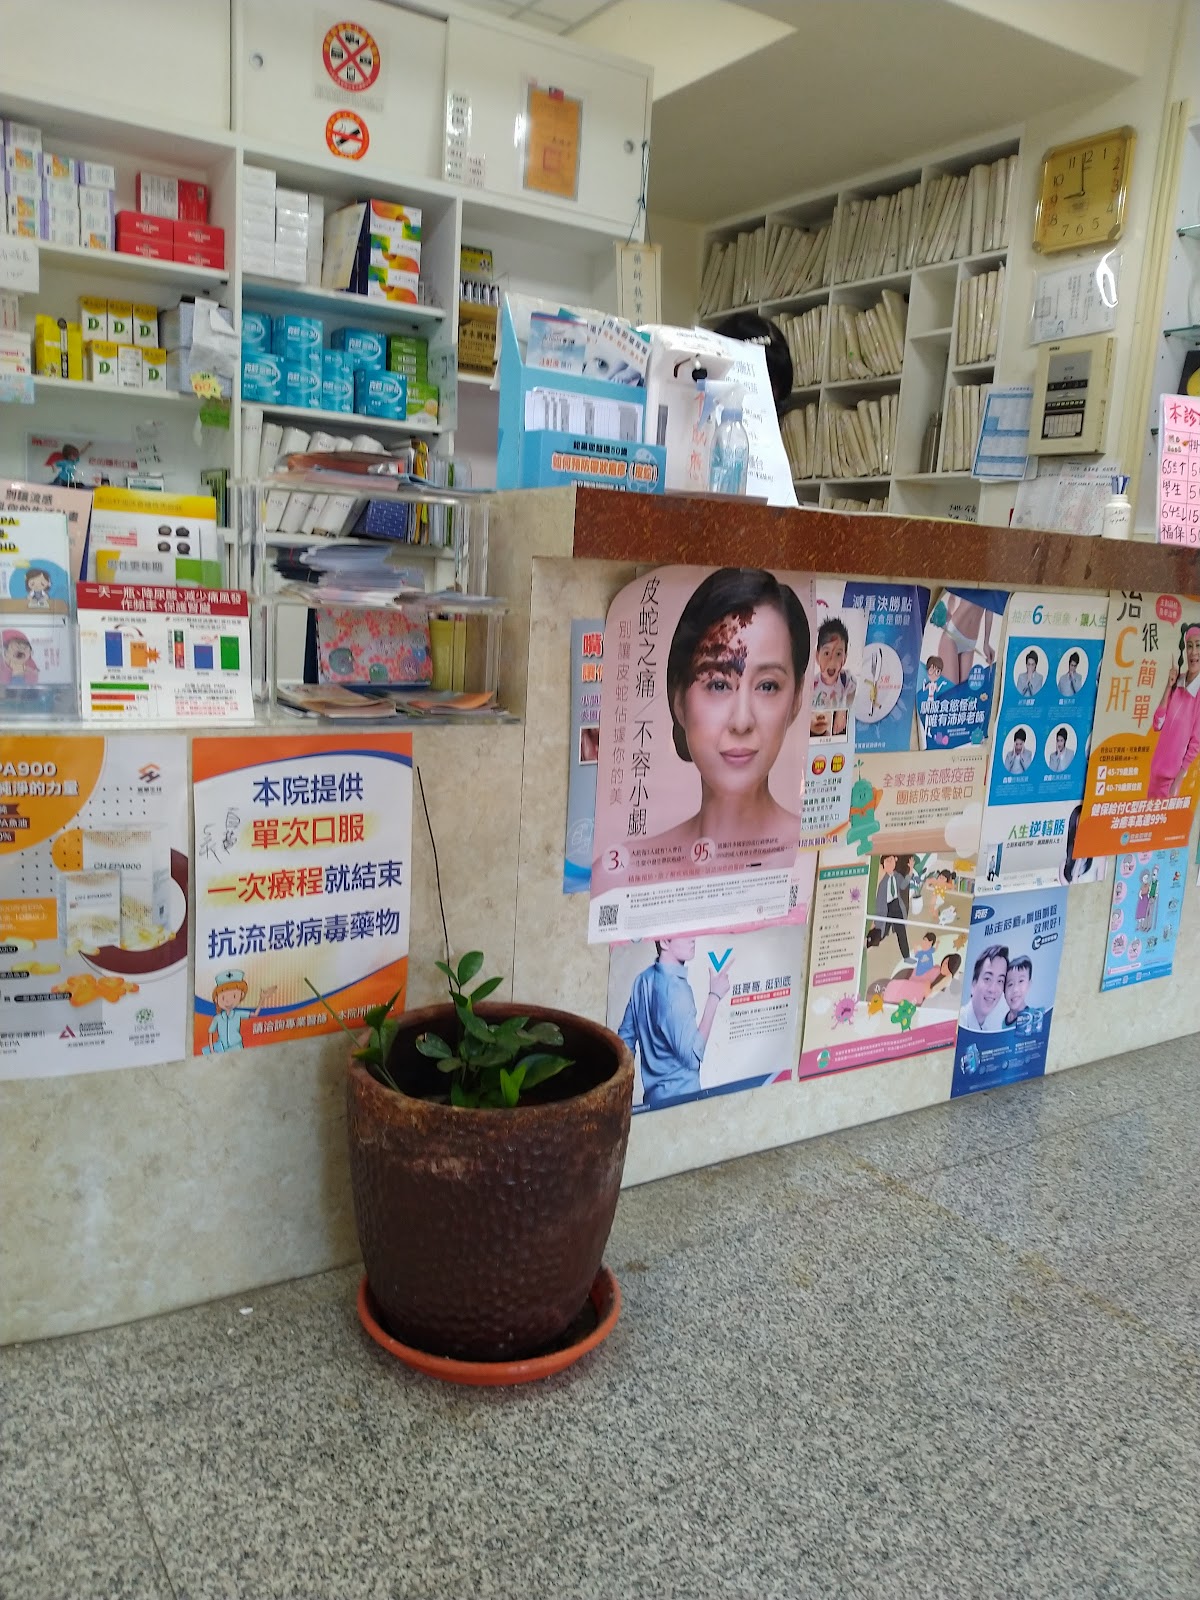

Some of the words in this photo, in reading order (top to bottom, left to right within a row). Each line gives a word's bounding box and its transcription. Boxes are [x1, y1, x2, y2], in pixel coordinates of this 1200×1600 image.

[1068, 156, 1076, 169] 11
[1053, 173, 1065, 186] 10
[1062, 224, 1070, 237] 7
[1091, 217, 1100, 230] 5
[252, 771, 365, 808] 本院提供
[250, 812, 366, 850] 單次口服
[207, 859, 404, 903] 一次療程就結束
[207, 907, 401, 960] 抗流感病毒藥物
